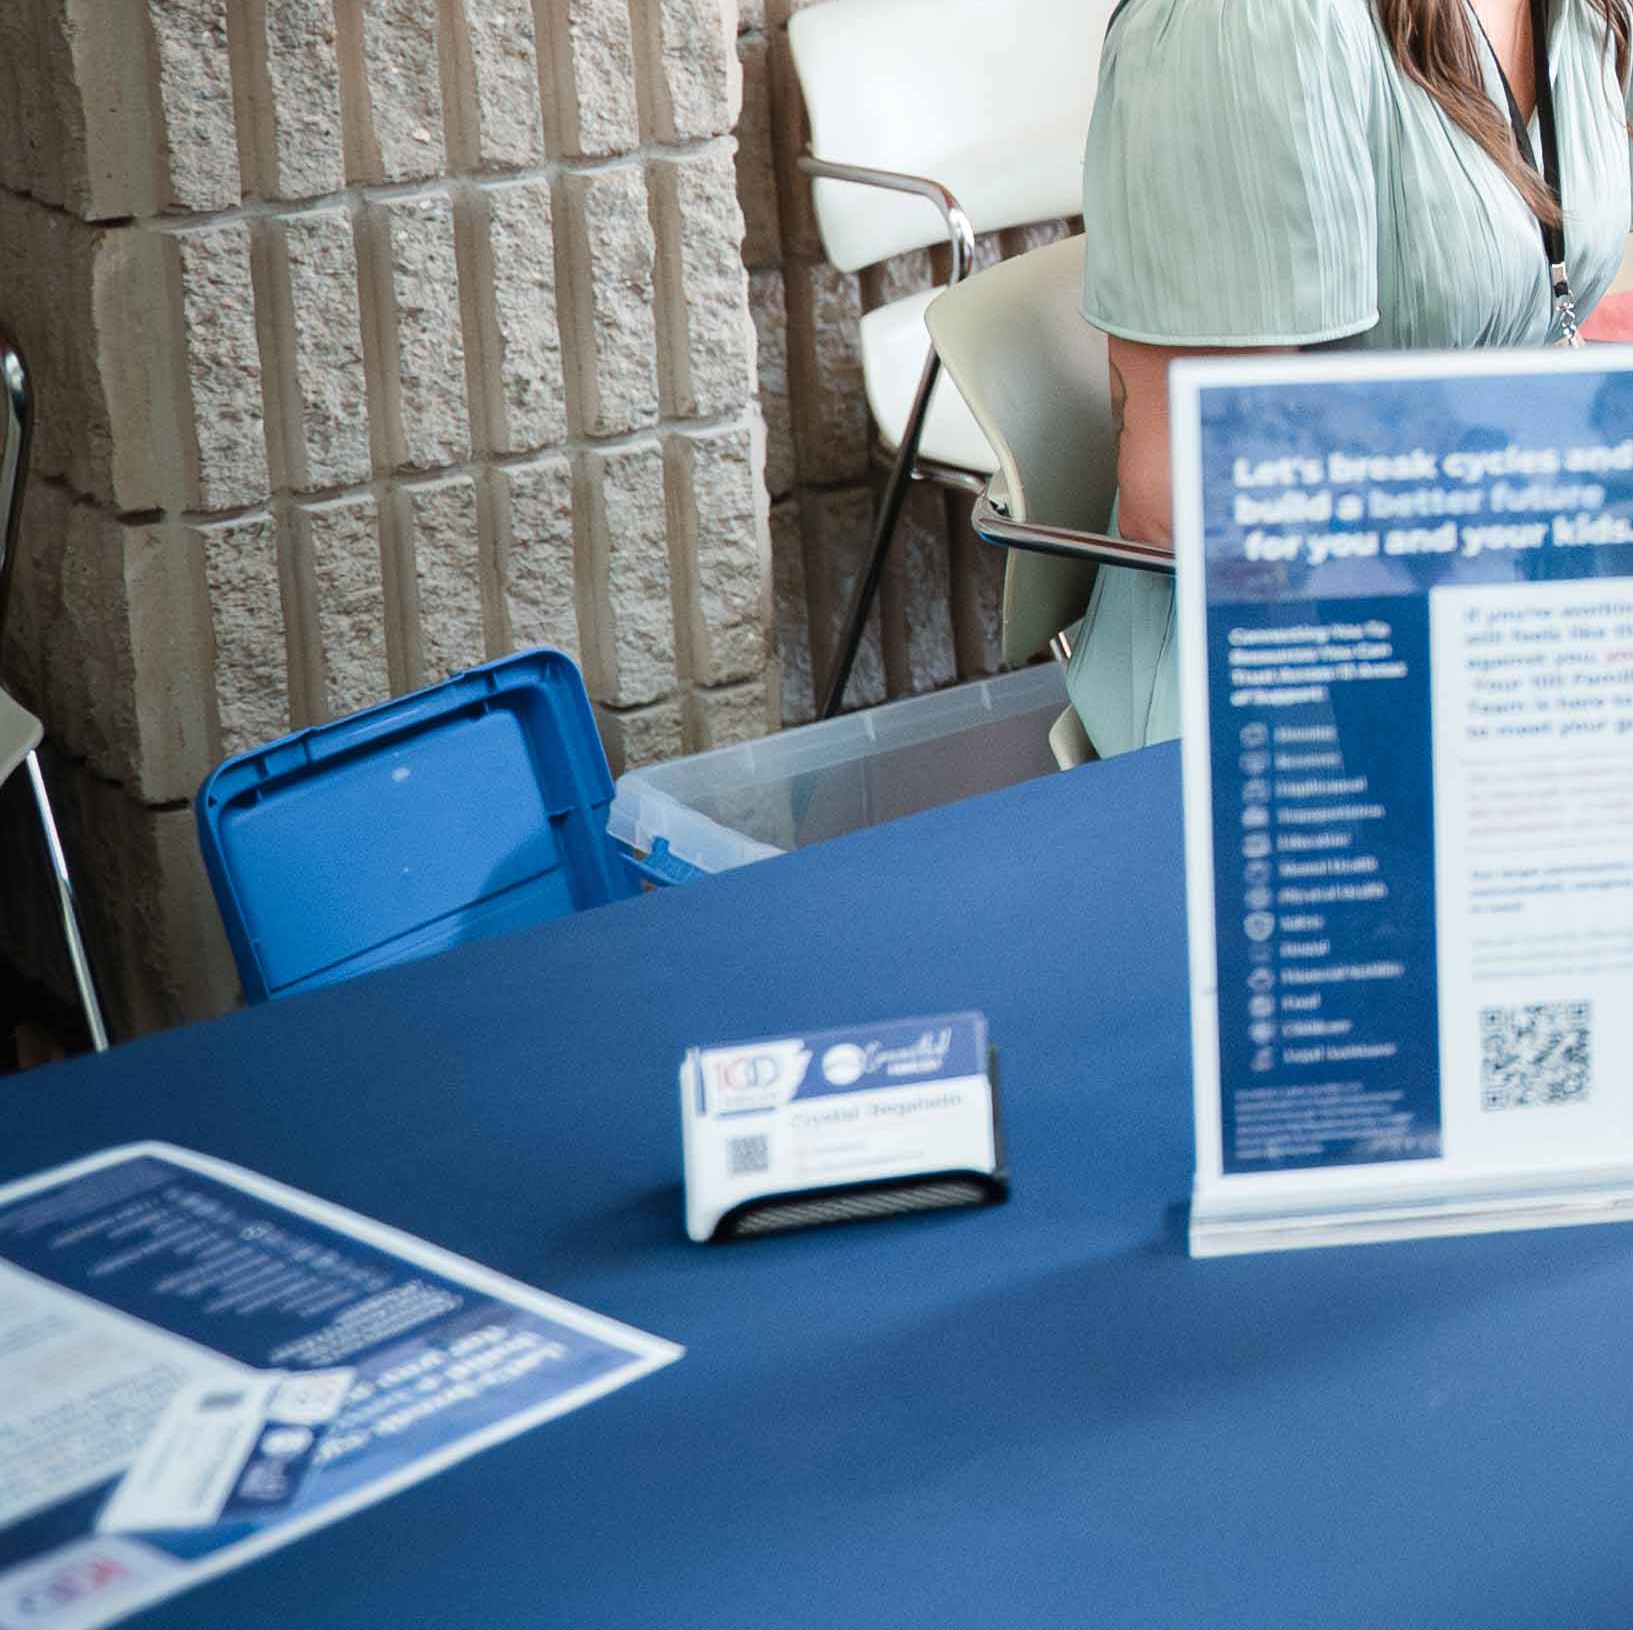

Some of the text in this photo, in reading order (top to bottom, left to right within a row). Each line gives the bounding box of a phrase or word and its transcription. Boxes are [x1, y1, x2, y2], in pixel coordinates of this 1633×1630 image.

[1234, 455, 1323, 488] Let's
[1329, 448, 1437, 483] break
[1443, 444, 1558, 483] cycles
[1234, 482, 1605, 525] build a better future
[1245, 530, 1300, 562] for
[1306, 531, 1379, 565] you
[1384, 521, 1457, 555] and
[1461, 522, 1549, 558] your
